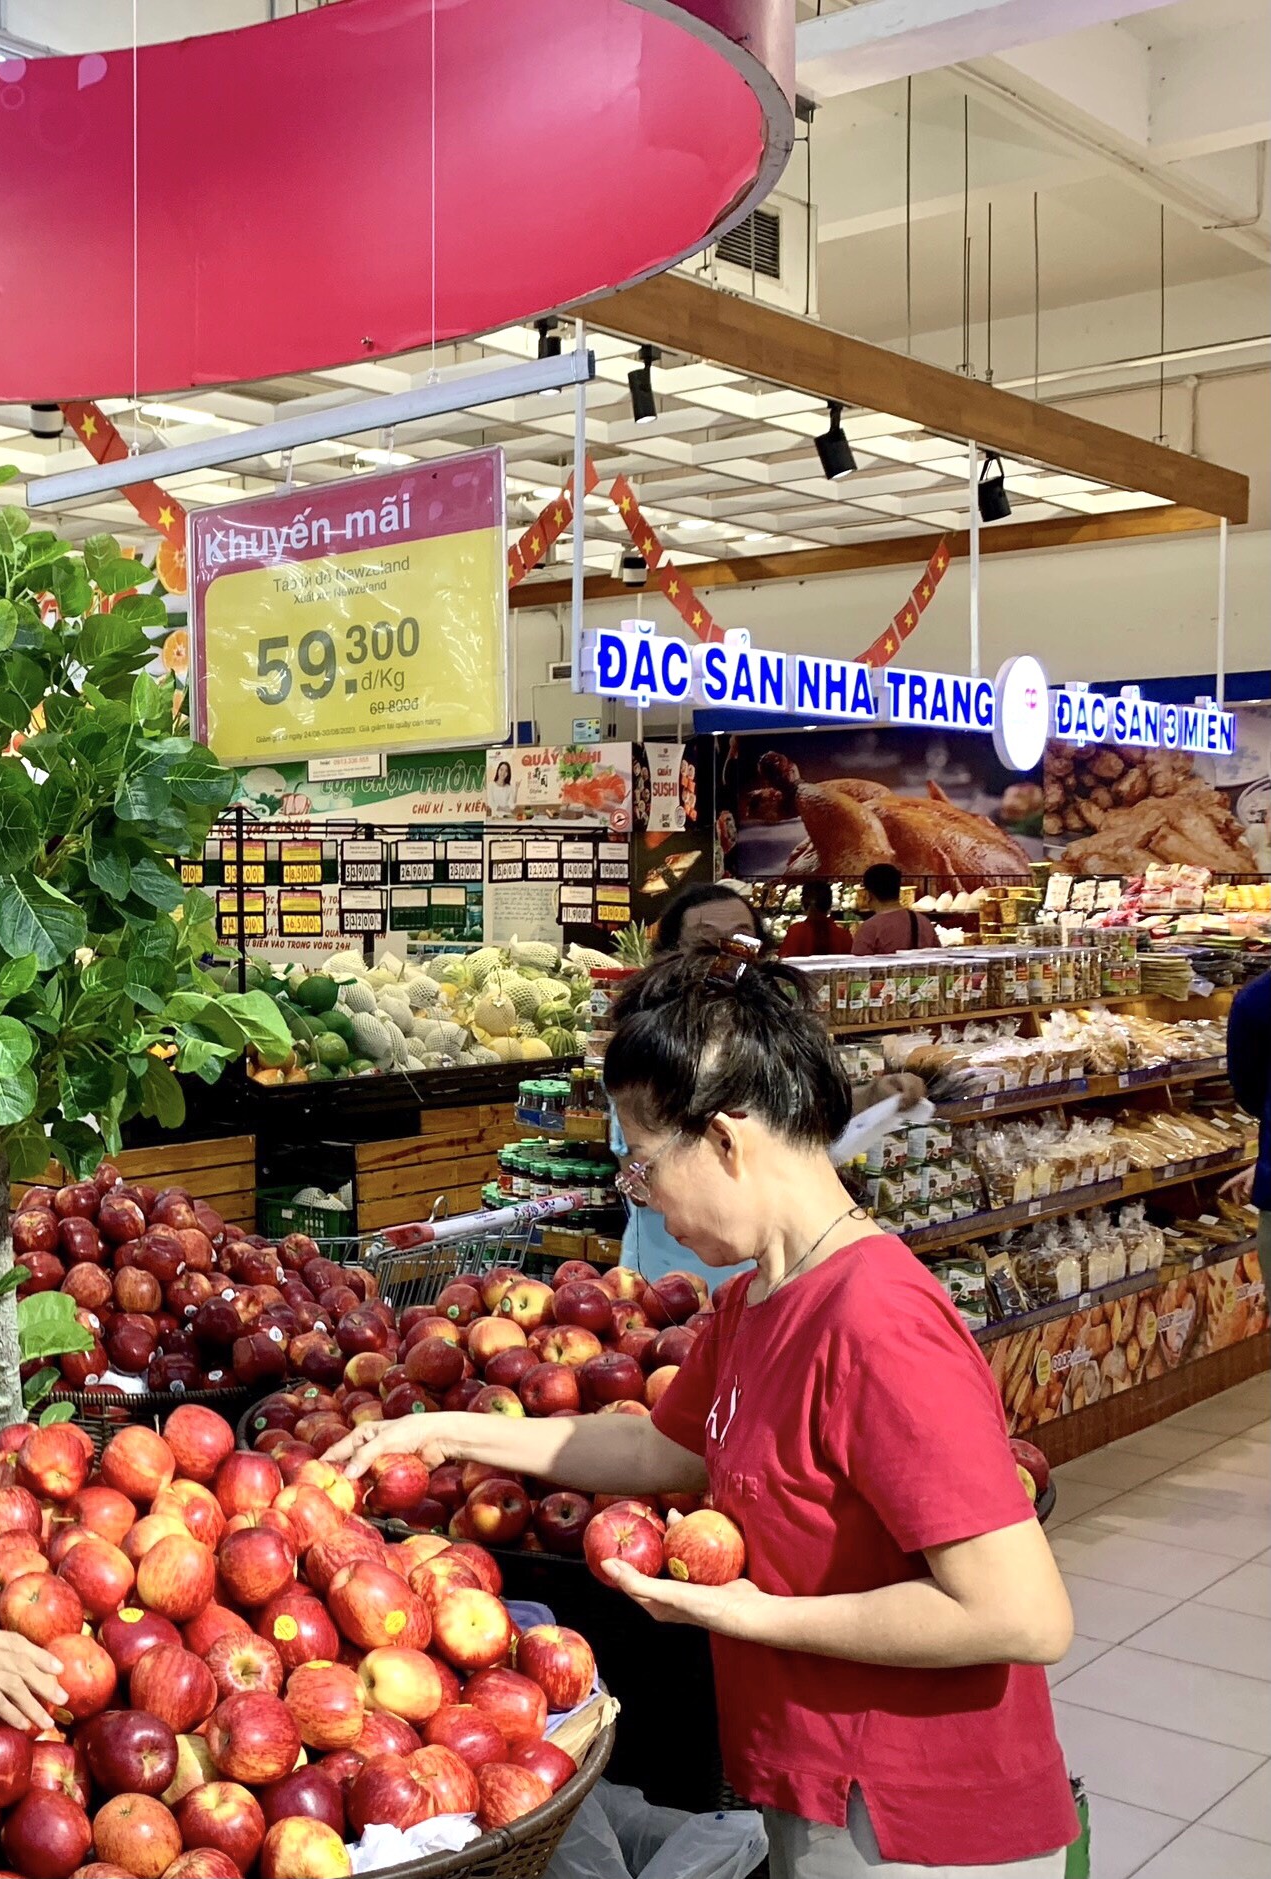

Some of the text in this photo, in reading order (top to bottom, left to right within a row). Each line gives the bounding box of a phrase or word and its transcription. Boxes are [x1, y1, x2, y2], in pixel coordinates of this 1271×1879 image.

[205, 493, 411, 565] Khuyến mãi
[361, 667, 406, 693] đ/Kg
[597, 624, 993, 727] ĐẶC SẢN NHA TRANG
[1057, 686, 1106, 745] ĐẶC
[1114, 688, 1159, 745] SẢN
[1163, 708, 1178, 744] 3
[418, 759, 487, 794] THÔN
[652, 782, 678, 798] SUSHI
